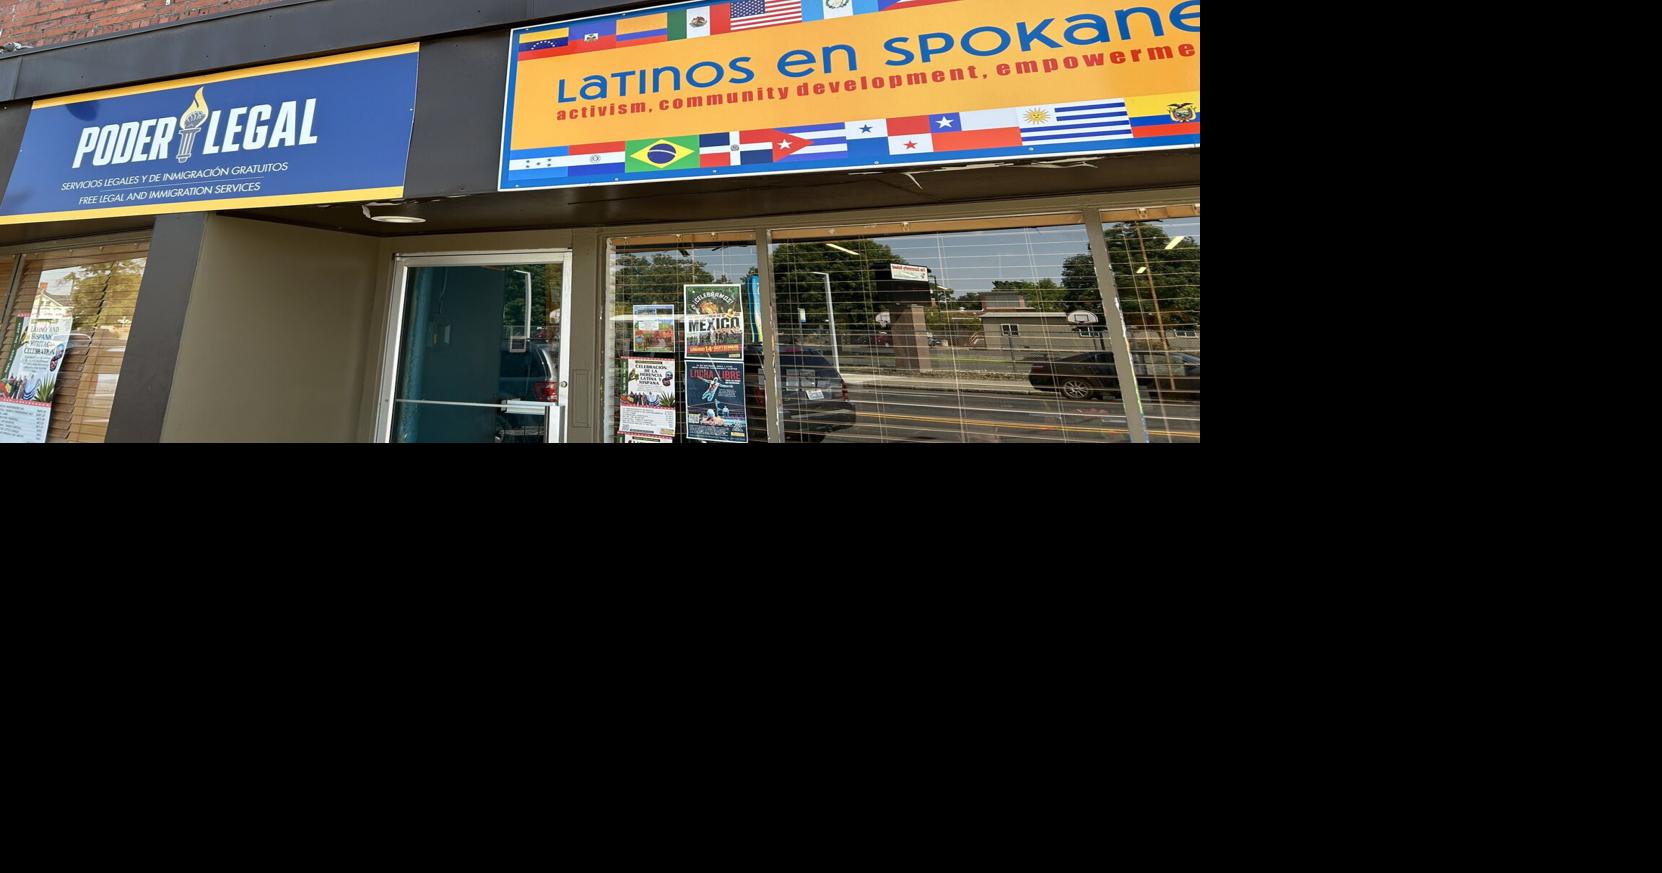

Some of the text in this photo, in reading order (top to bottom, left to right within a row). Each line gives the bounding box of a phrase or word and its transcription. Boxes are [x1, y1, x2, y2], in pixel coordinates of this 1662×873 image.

[777, 43, 857, 78] en
[556, 41, 1196, 121] activism, community development, empowerme
[72, 98, 318, 169] PODER LEGAL
[61, 162, 288, 191] SERVICIOS LEGALES Y DE INMIGRACIÓN GRATUITOS
[79, 182, 261, 205] FREE LEGAL AND IMMIGRATION SERVICES
